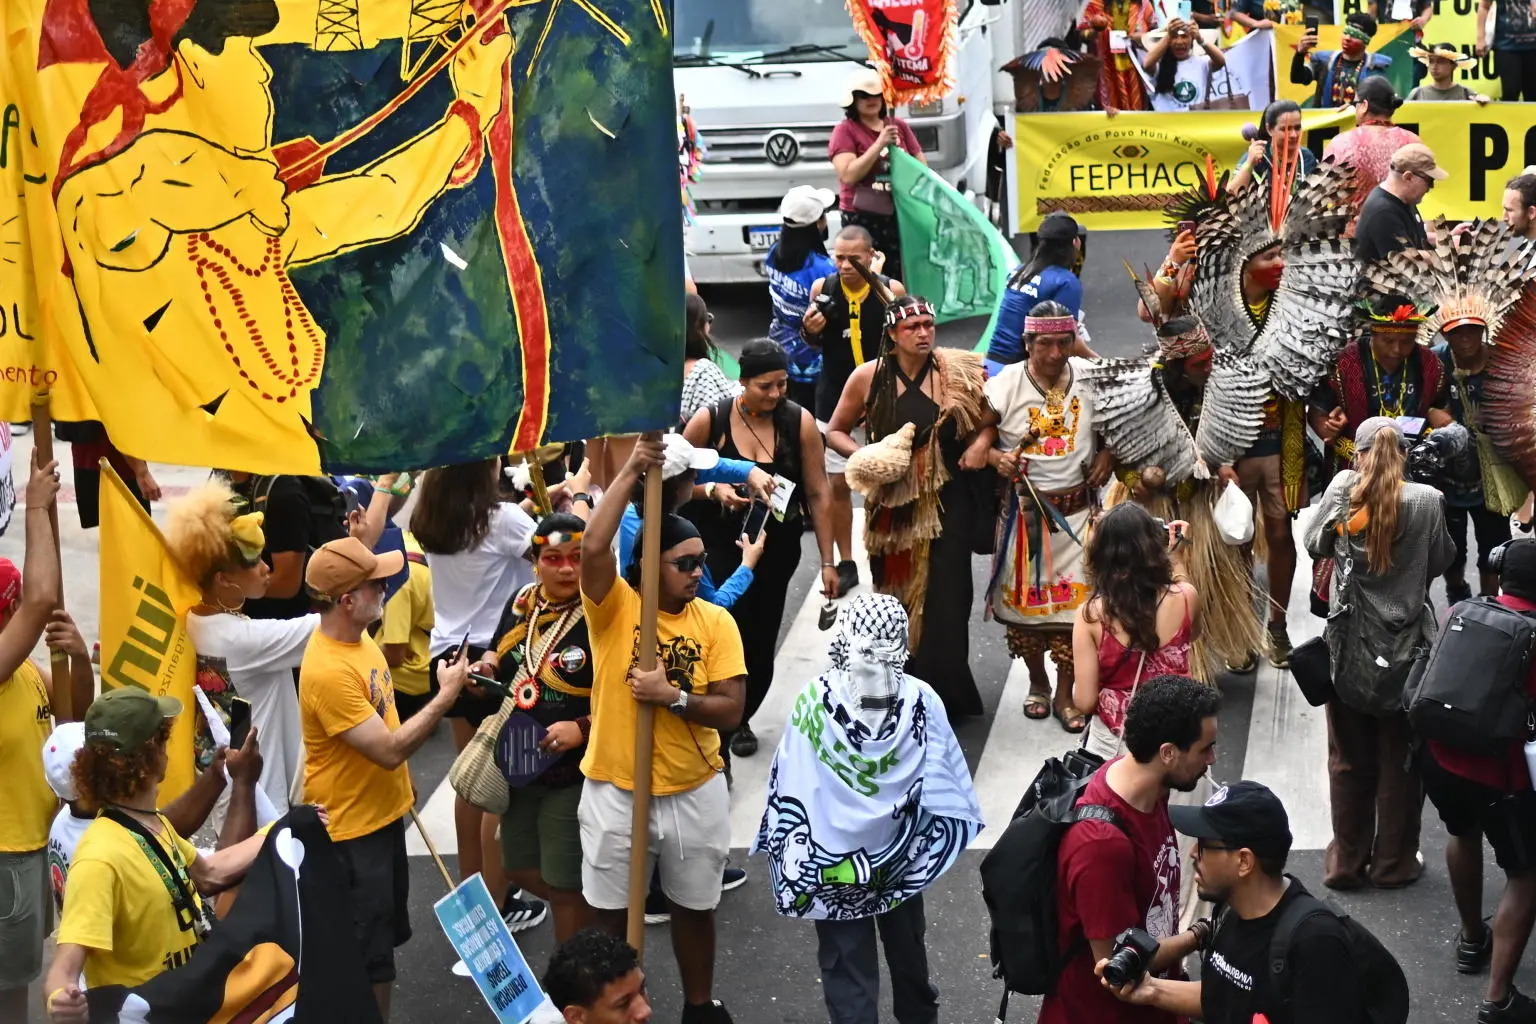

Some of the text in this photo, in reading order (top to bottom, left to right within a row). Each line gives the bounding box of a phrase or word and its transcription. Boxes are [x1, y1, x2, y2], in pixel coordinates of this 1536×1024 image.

[1039, 140, 1080, 191] Federação
[1085, 133, 1100, 144] do
[1105, 129, 1134, 139] Povo
[1140, 129, 1168, 141] Huni
[1173, 136, 1194, 149] Kui
[493, 973, 528, 1011] DEMARCAR
